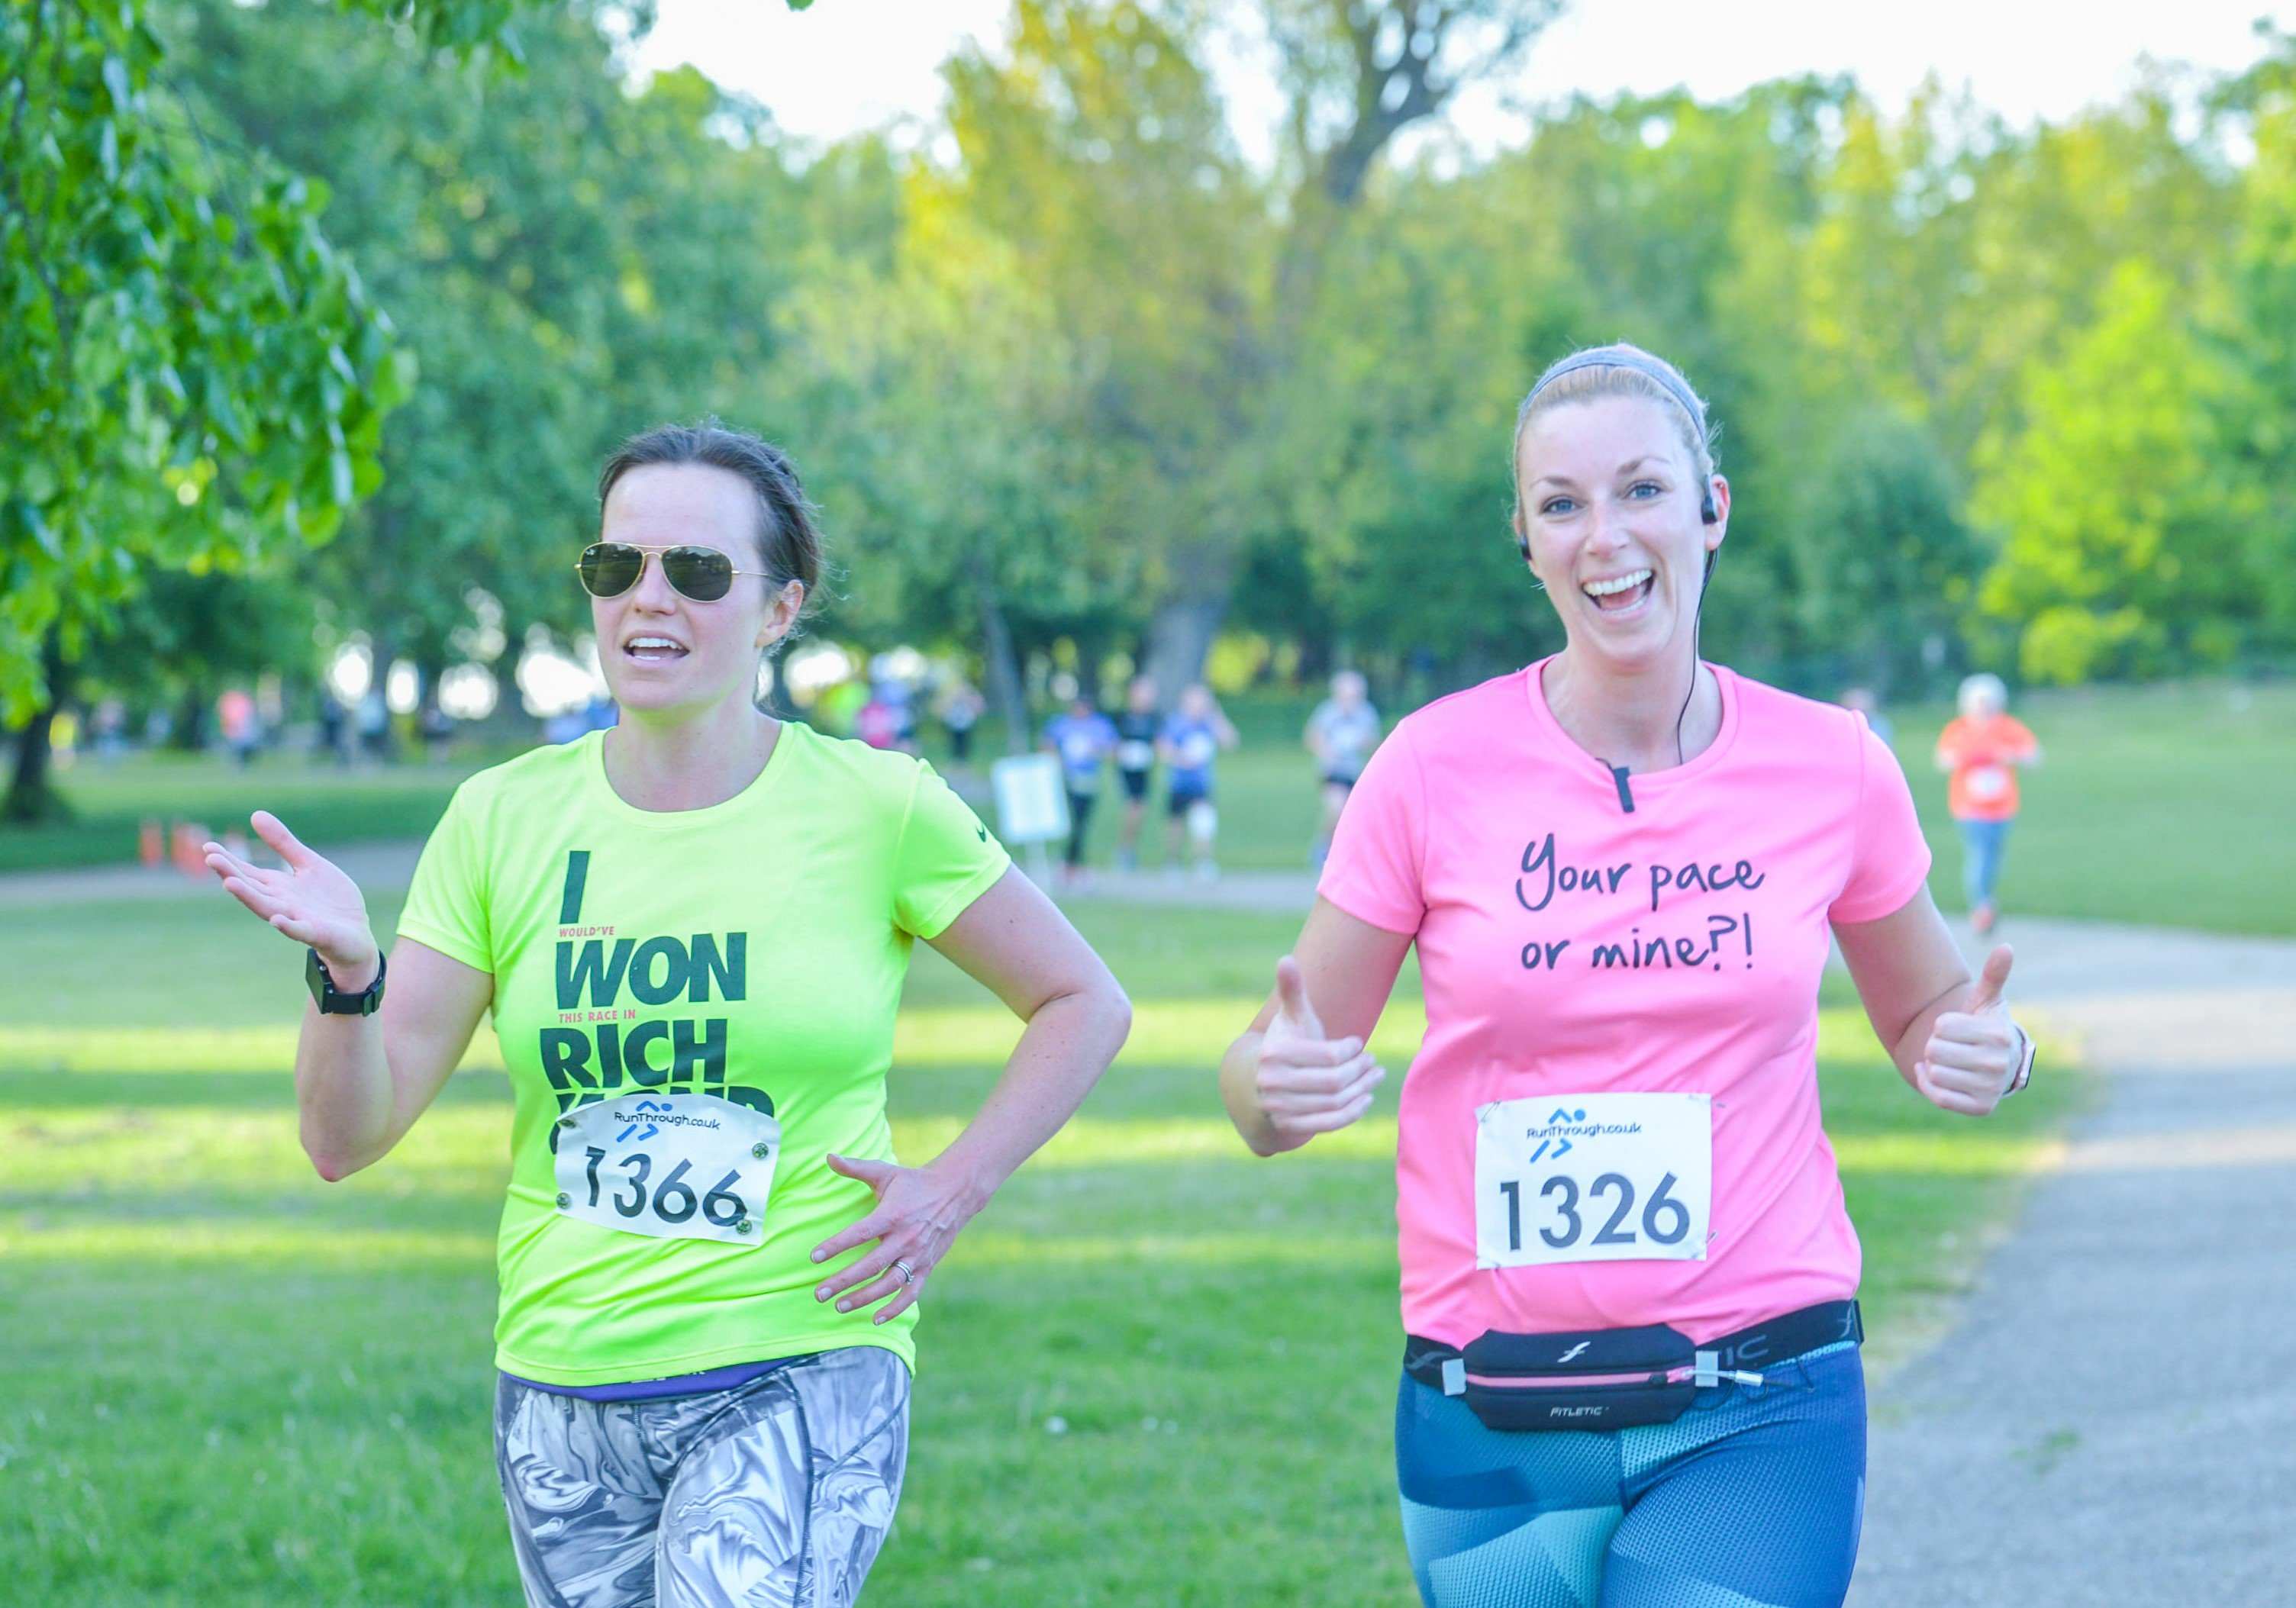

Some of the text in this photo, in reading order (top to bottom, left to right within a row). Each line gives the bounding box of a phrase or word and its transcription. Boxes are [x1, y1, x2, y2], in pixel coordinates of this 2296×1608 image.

[559, 850, 591, 923] I
[1515, 833, 1765, 912] Your pace
[559, 926, 615, 937] WOULD'VE
[1521, 913, 1753, 971] or mine?!
[556, 933, 747, 1009] WON
[559, 1009, 636, 1023] THIS RACE IN
[539, 1018, 727, 1090] RICH
[585, 1146, 748, 1226] 1366
[1500, 1171, 1691, 1252] 1326
[1549, 1406, 1602, 1417] FITLETIC
